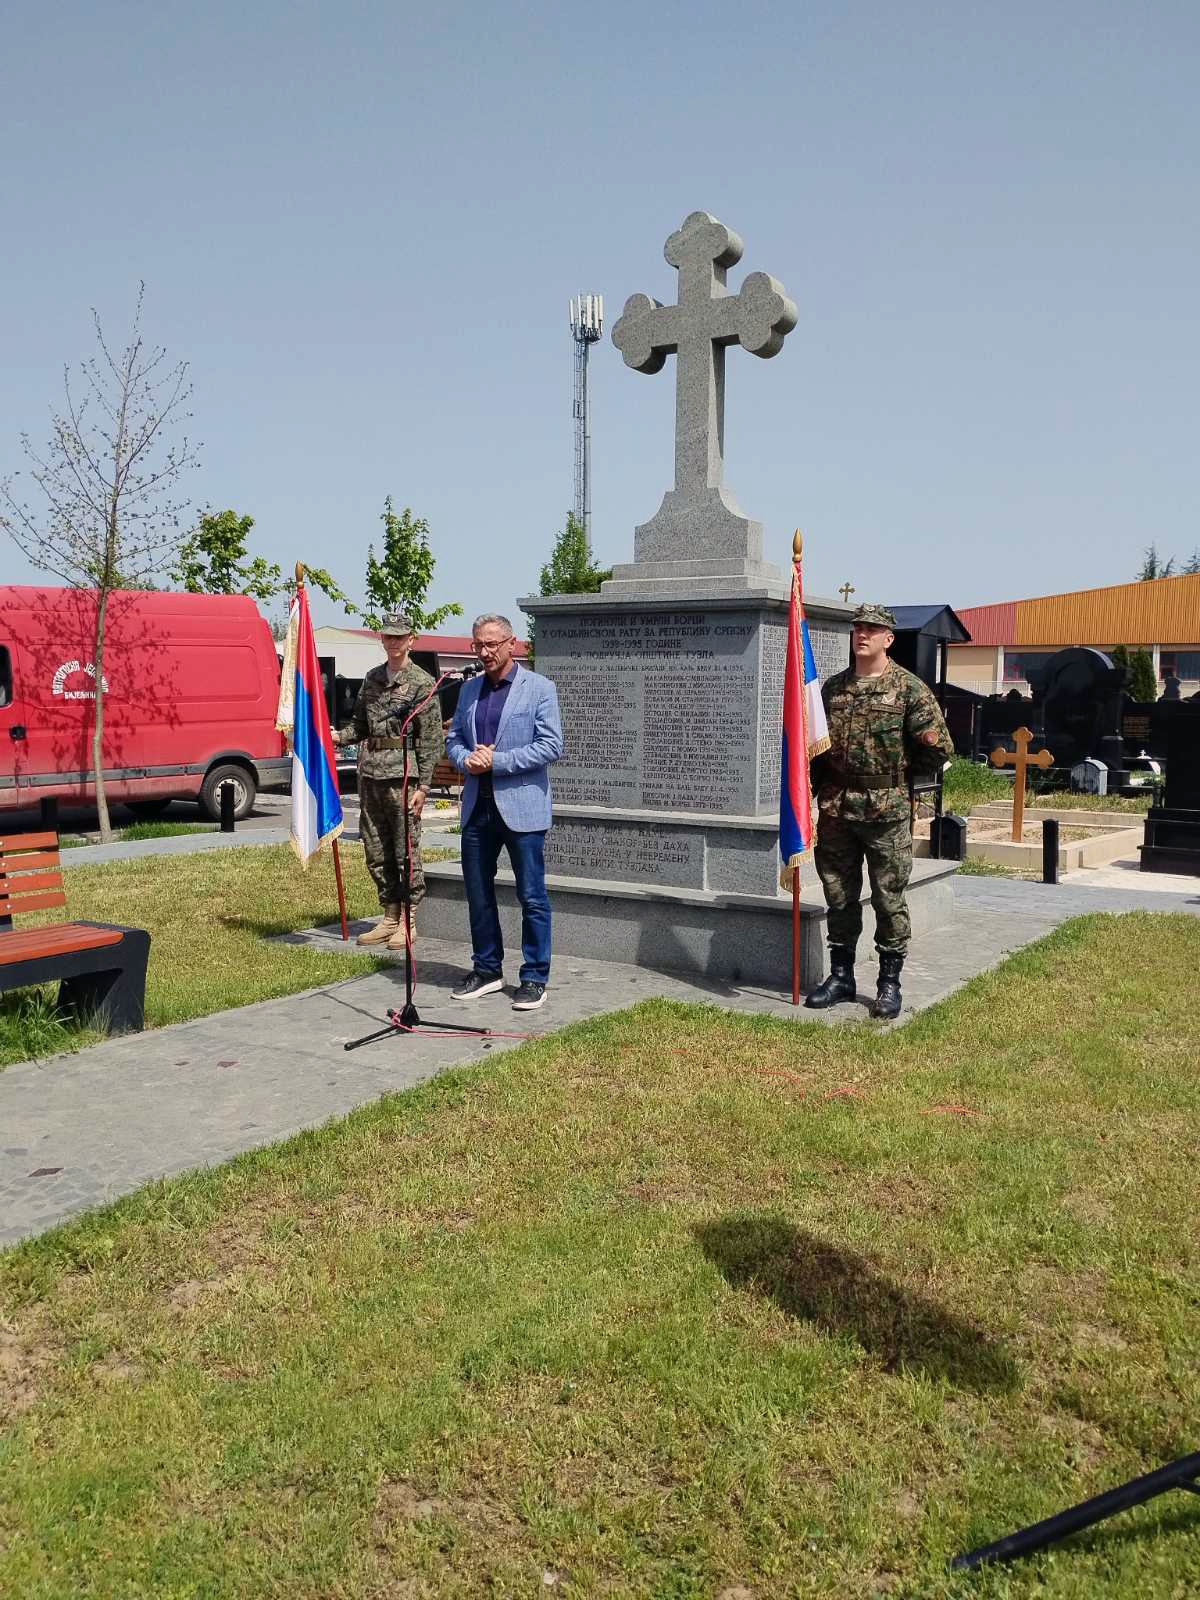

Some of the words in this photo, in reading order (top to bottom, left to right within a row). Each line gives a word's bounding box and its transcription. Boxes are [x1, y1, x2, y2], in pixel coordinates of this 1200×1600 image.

[542, 629, 548, 638] У
[619, 628, 640, 638] РАТУ
[644, 628, 655, 637] ЗА
[659, 627, 711, 636] РЕПУБЛИКУ
[714, 626, 753, 635] СРПСКУ
[646, 640, 682, 648] ГОДИНЕ
[634, 651, 681, 659] ОПШТИНЕ
[686, 650, 715, 659] ТУЗЛА
